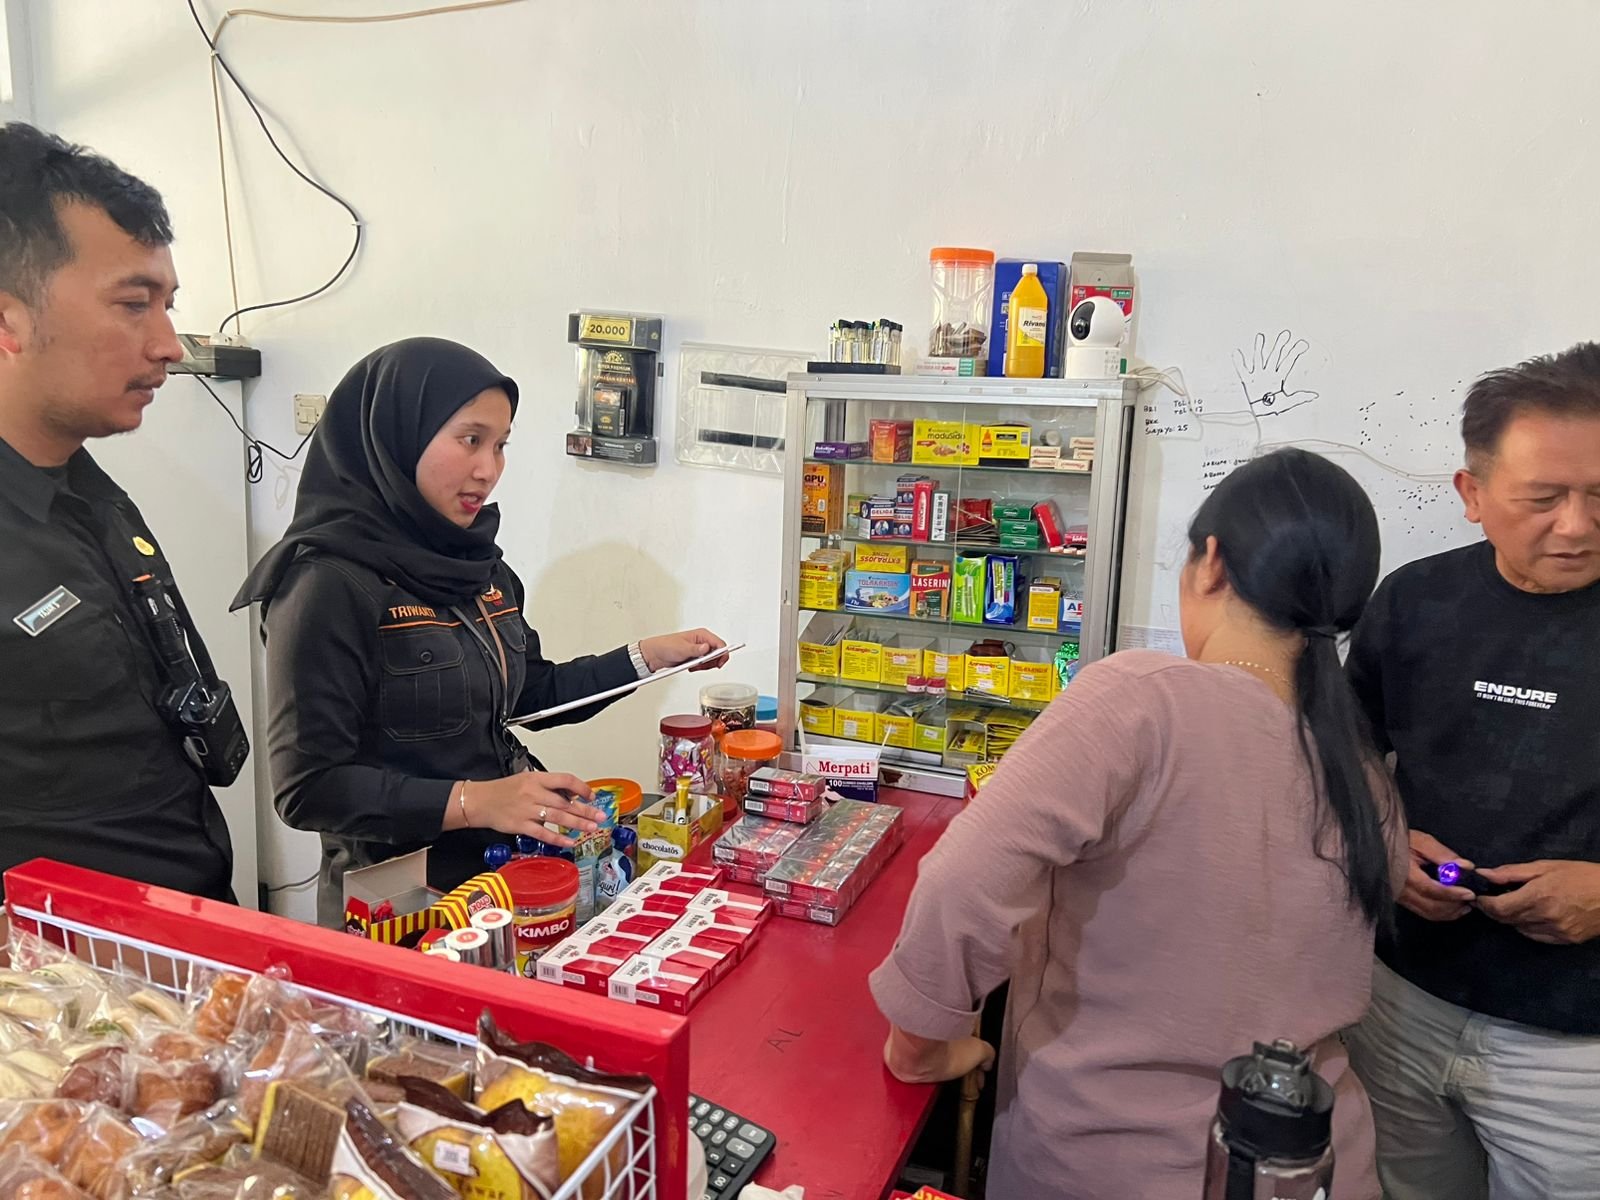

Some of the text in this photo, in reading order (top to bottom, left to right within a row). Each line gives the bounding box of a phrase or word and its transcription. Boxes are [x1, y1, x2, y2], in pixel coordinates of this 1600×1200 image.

[589, 324, 625, 336] 20.000
[804, 475, 824, 483] GPU
[912, 578, 947, 588] LASERIN
[388, 605, 436, 619] TRIWANTI
[1474, 681, 1557, 703] ENDURE
[818, 760, 871, 777] Merpati
[829, 779, 843, 787] 100
[518, 919, 570, 938] KIMBO
